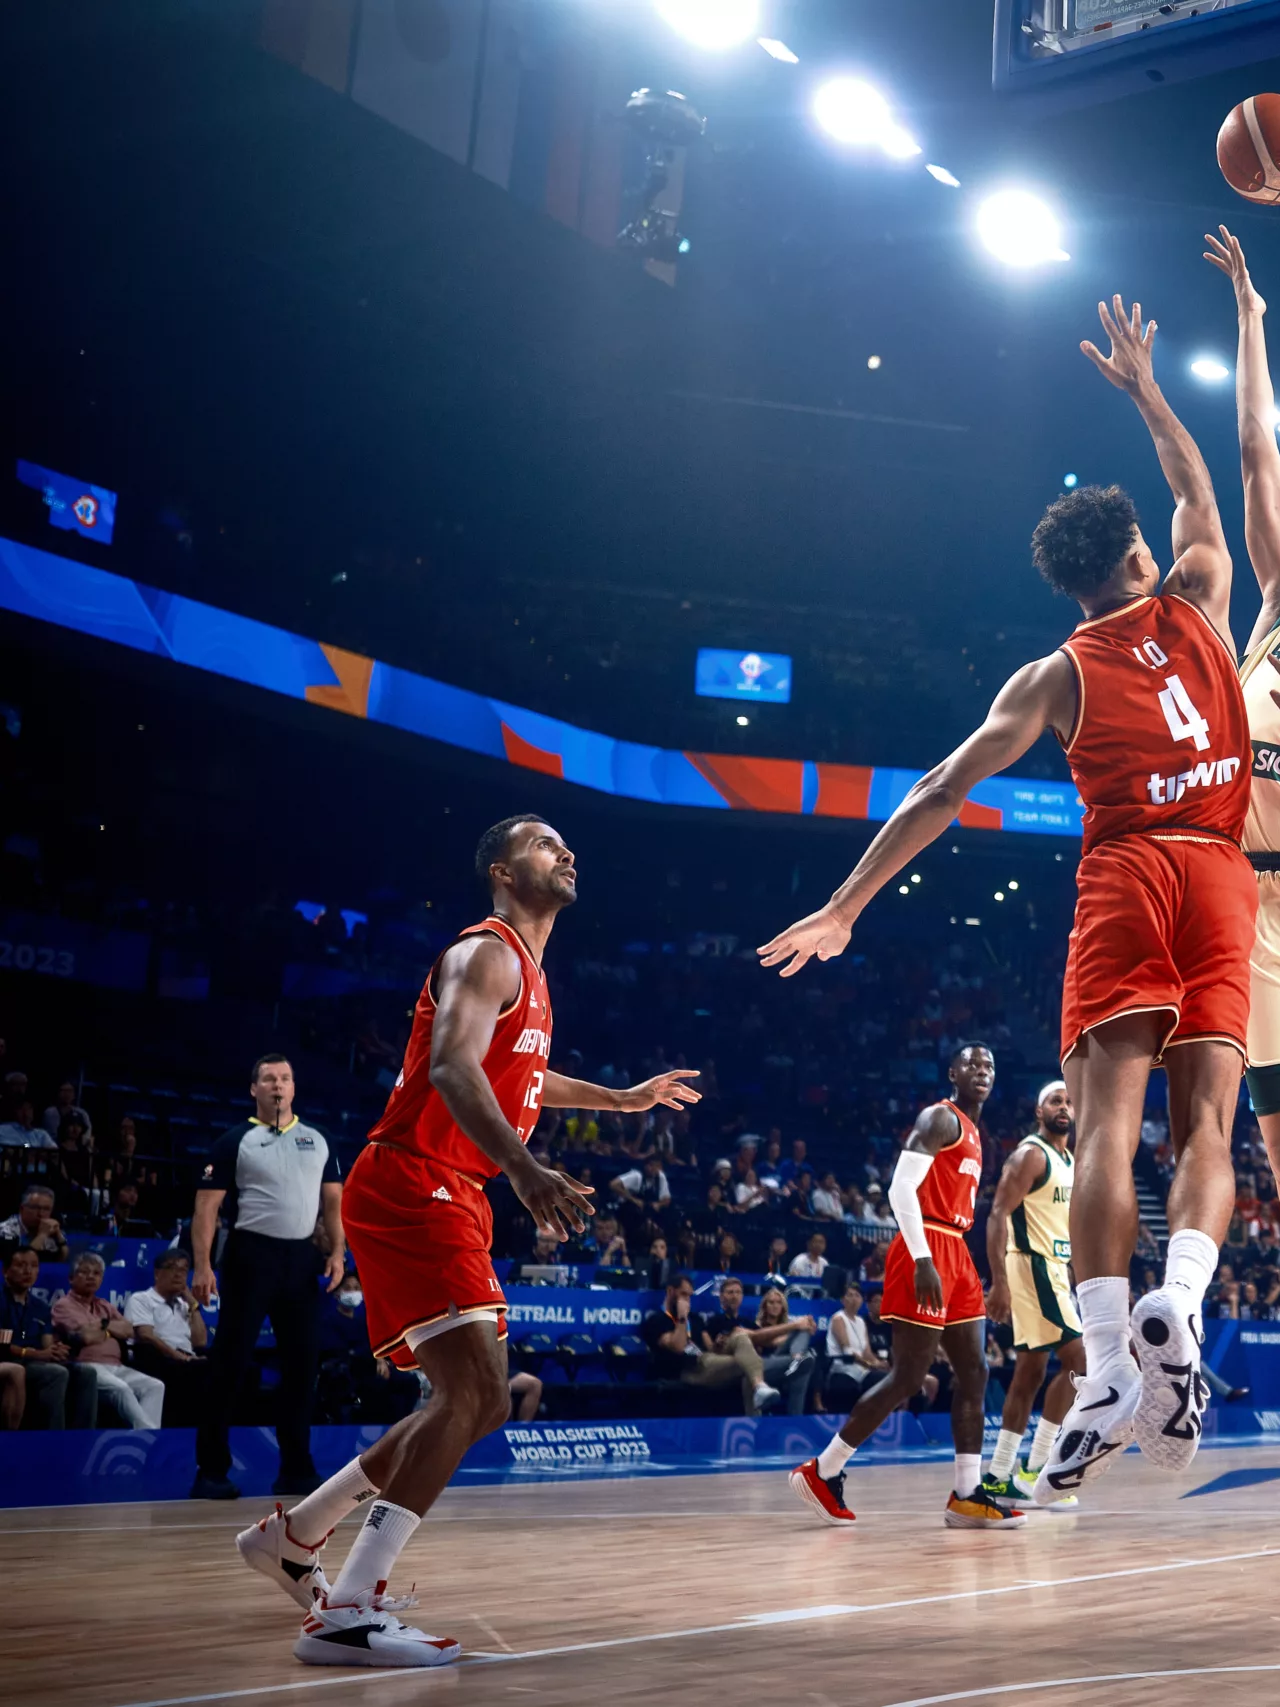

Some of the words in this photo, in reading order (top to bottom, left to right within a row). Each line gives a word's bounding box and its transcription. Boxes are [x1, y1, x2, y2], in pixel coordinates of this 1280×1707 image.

[1157, 674, 1211, 751] 4
[583, 1307, 642, 1325] WORLD
[504, 1429, 544, 1443] FIBA
[543, 1425, 643, 1443] BASKETBALL
[510, 1445, 573, 1461] WORLD
[573, 1443, 607, 1459] CUP
[608, 1441, 650, 1456] 2023
